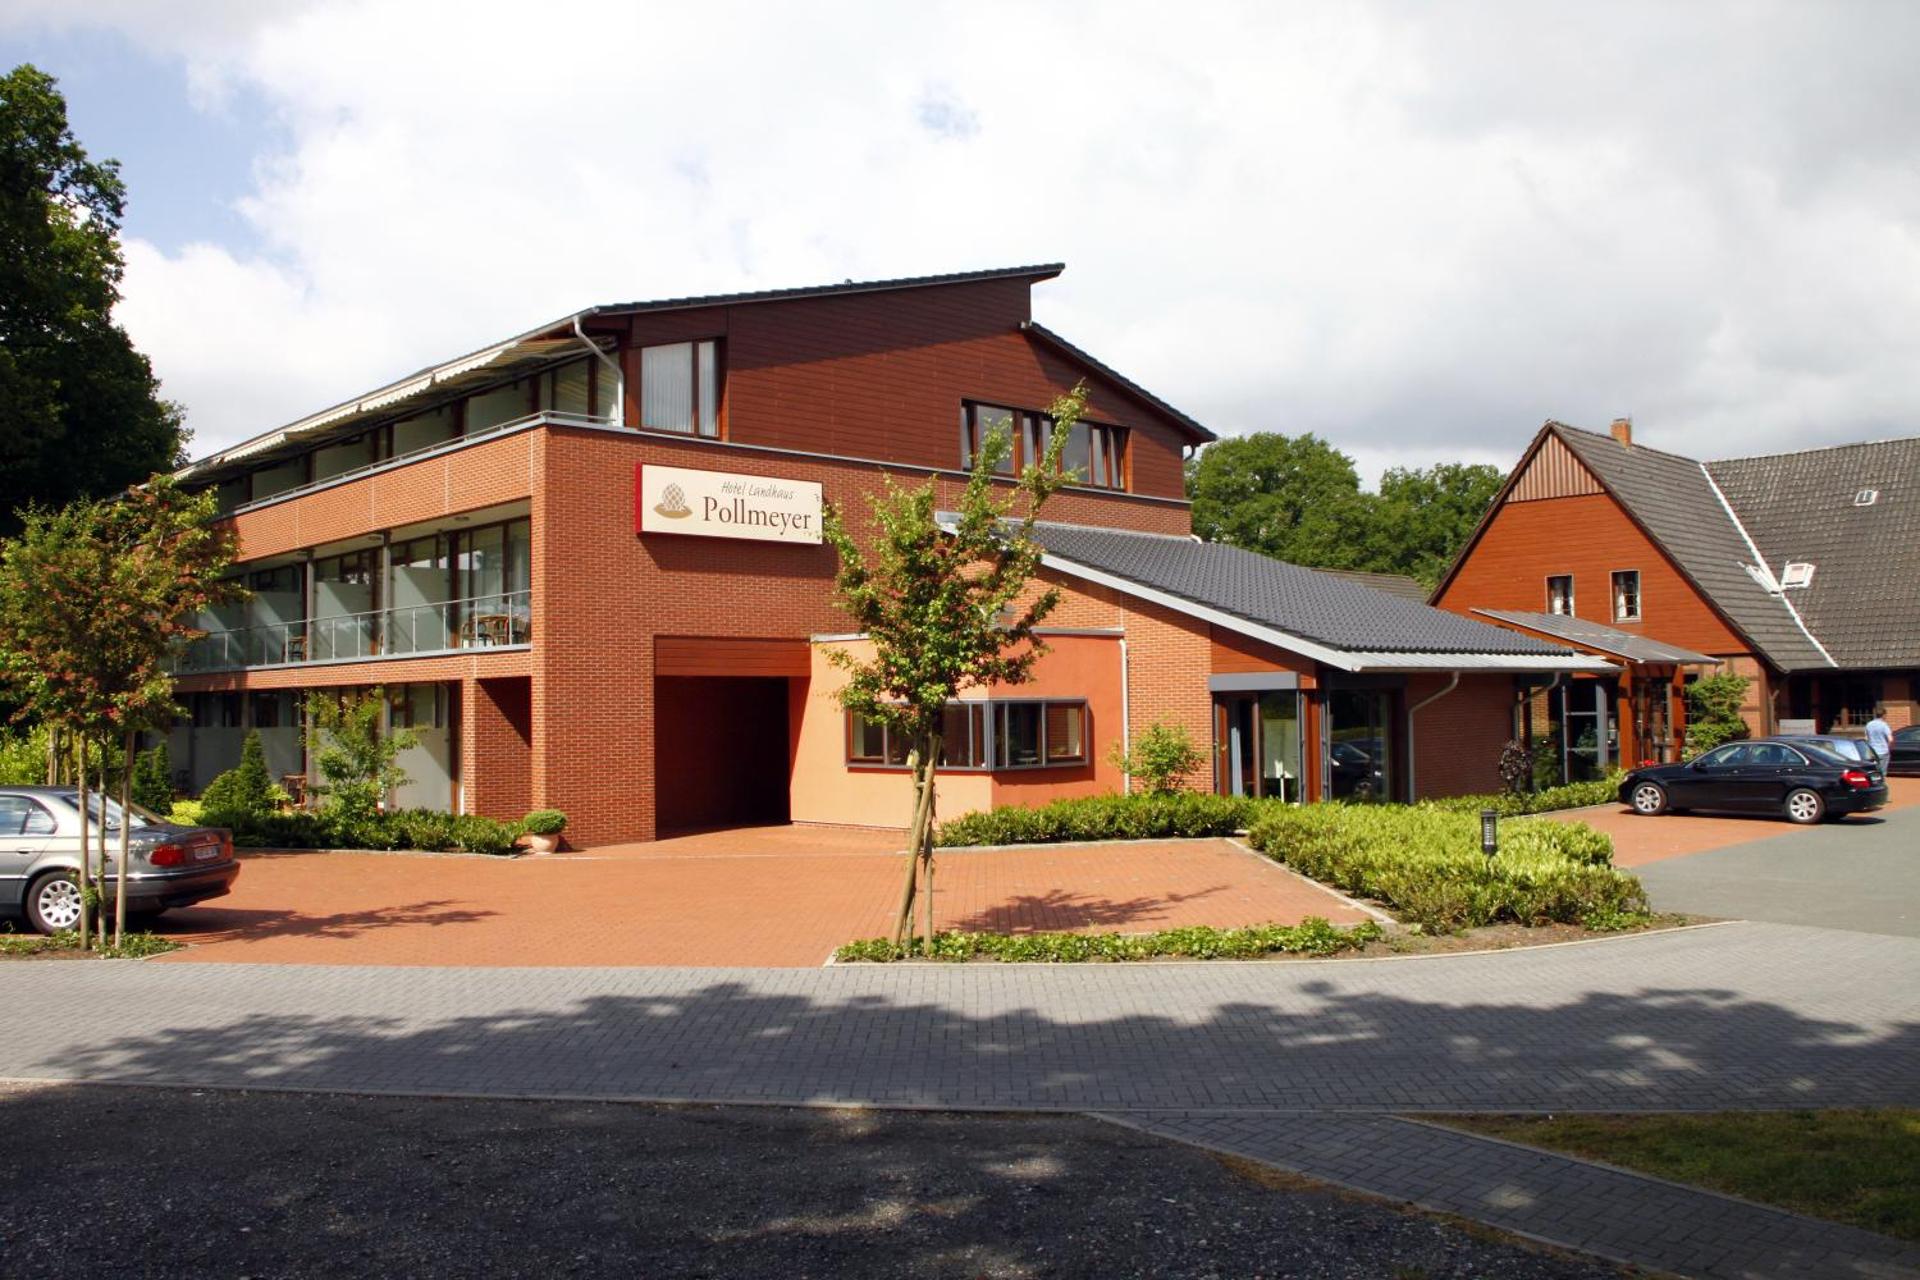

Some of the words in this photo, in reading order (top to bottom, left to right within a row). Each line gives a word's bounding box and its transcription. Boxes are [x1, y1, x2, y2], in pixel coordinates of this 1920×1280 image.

[721, 481, 745, 496] Hotel
[748, 484, 795, 500] Landhaus
[704, 496, 811, 535] Pollmeyer
